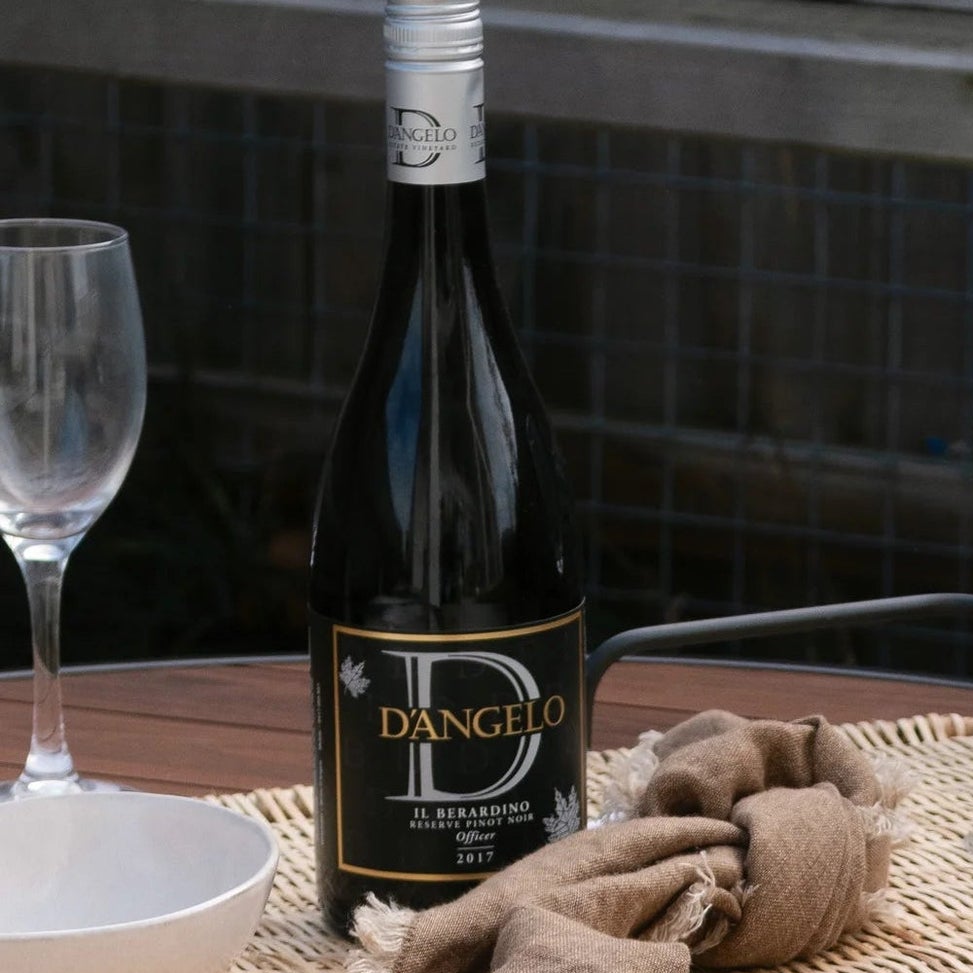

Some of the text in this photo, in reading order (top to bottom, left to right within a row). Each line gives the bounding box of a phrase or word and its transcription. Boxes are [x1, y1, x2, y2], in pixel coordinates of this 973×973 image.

[390, 106, 441, 168] D
[379, 695, 565, 741] D'ANGELO
[381, 650, 541, 802] D
[414, 801, 530, 819] IL BERARDINO
[409, 812, 534, 829] RESERVE PINOT NOIR
[455, 830, 496, 845] Officer
[456, 851, 494, 864] 2017
